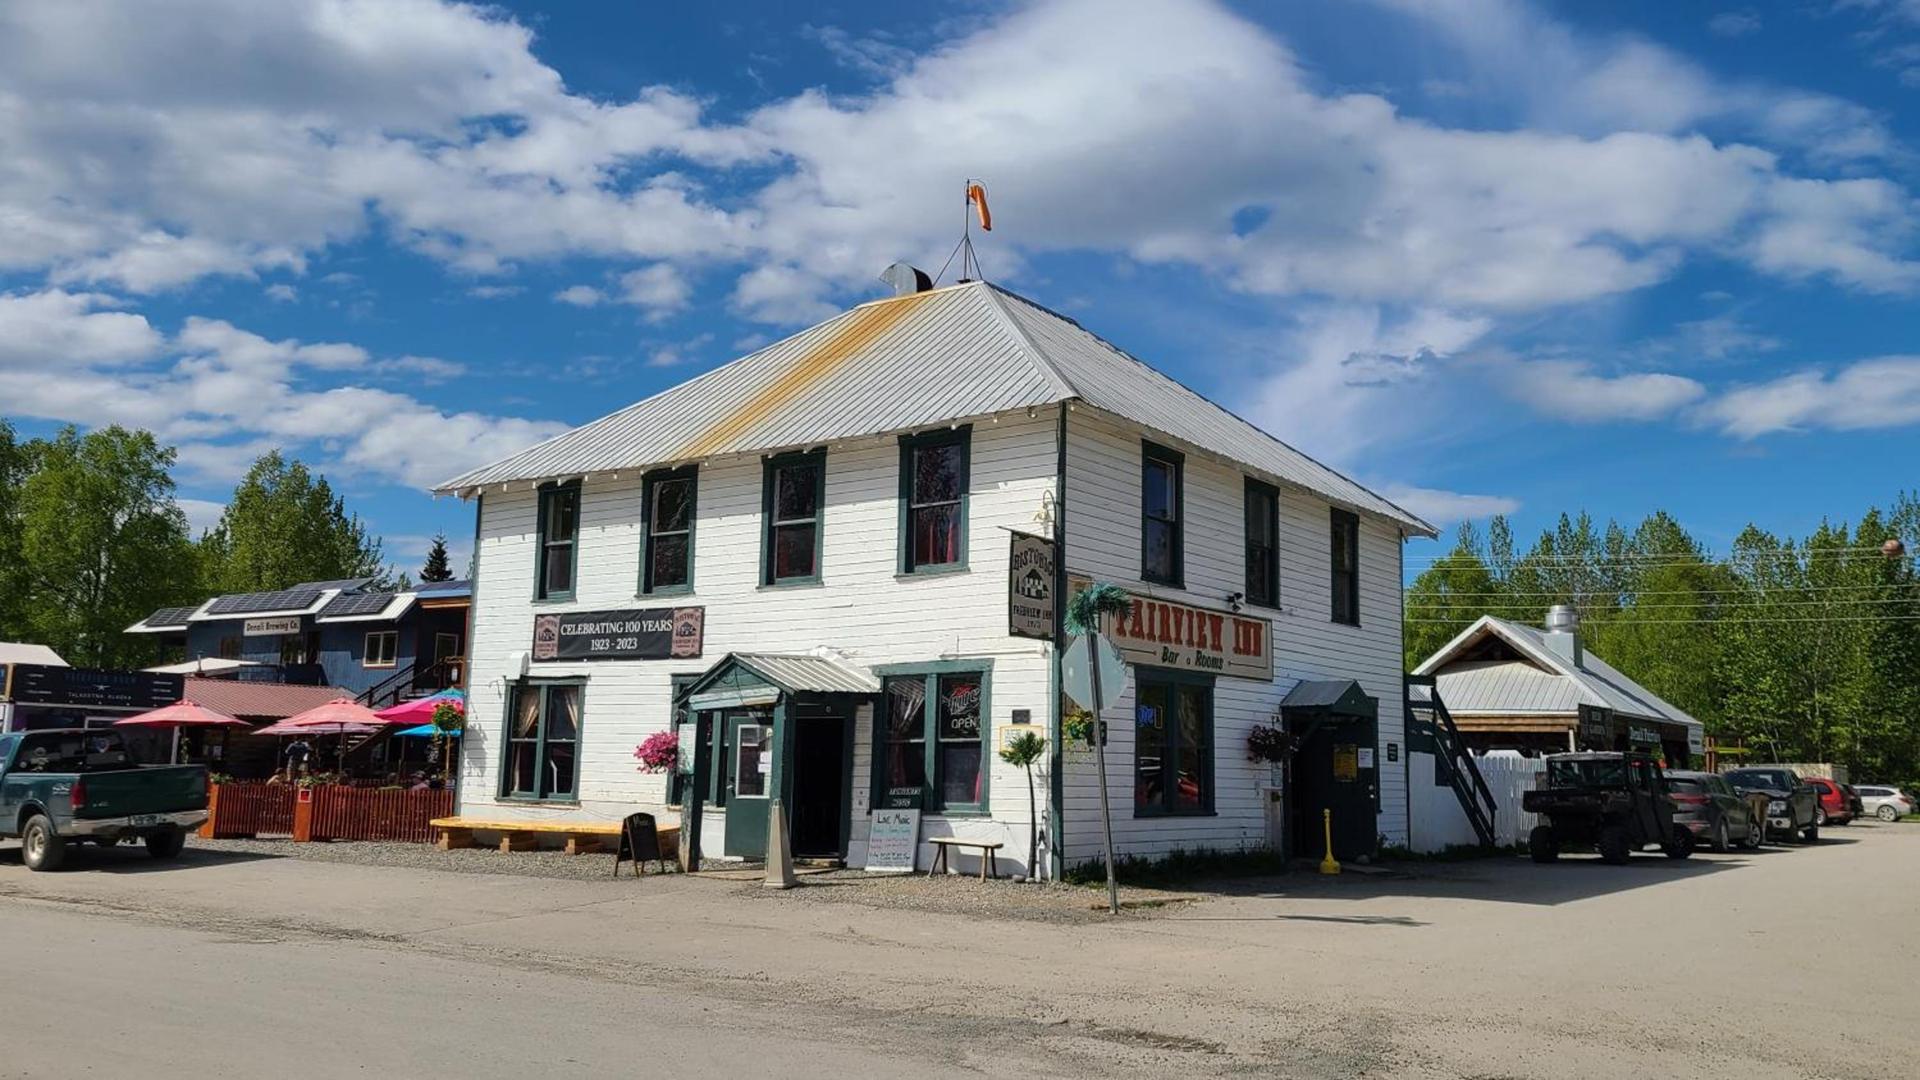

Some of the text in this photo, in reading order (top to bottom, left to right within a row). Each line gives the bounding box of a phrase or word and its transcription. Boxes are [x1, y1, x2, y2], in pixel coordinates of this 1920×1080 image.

[560, 621, 624, 636] CELEBRATING
[625, 620, 641, 633] 100
[642, 619, 673, 632] YEARS
[590, 638, 610, 651] 1923
[616, 637, 638, 650] 2023
[1232, 617, 1263, 657] INN
[1161, 646, 1181, 665] Bar
[1194, 650, 1224, 670] Rooms
[951, 718, 977, 729] OPEN
